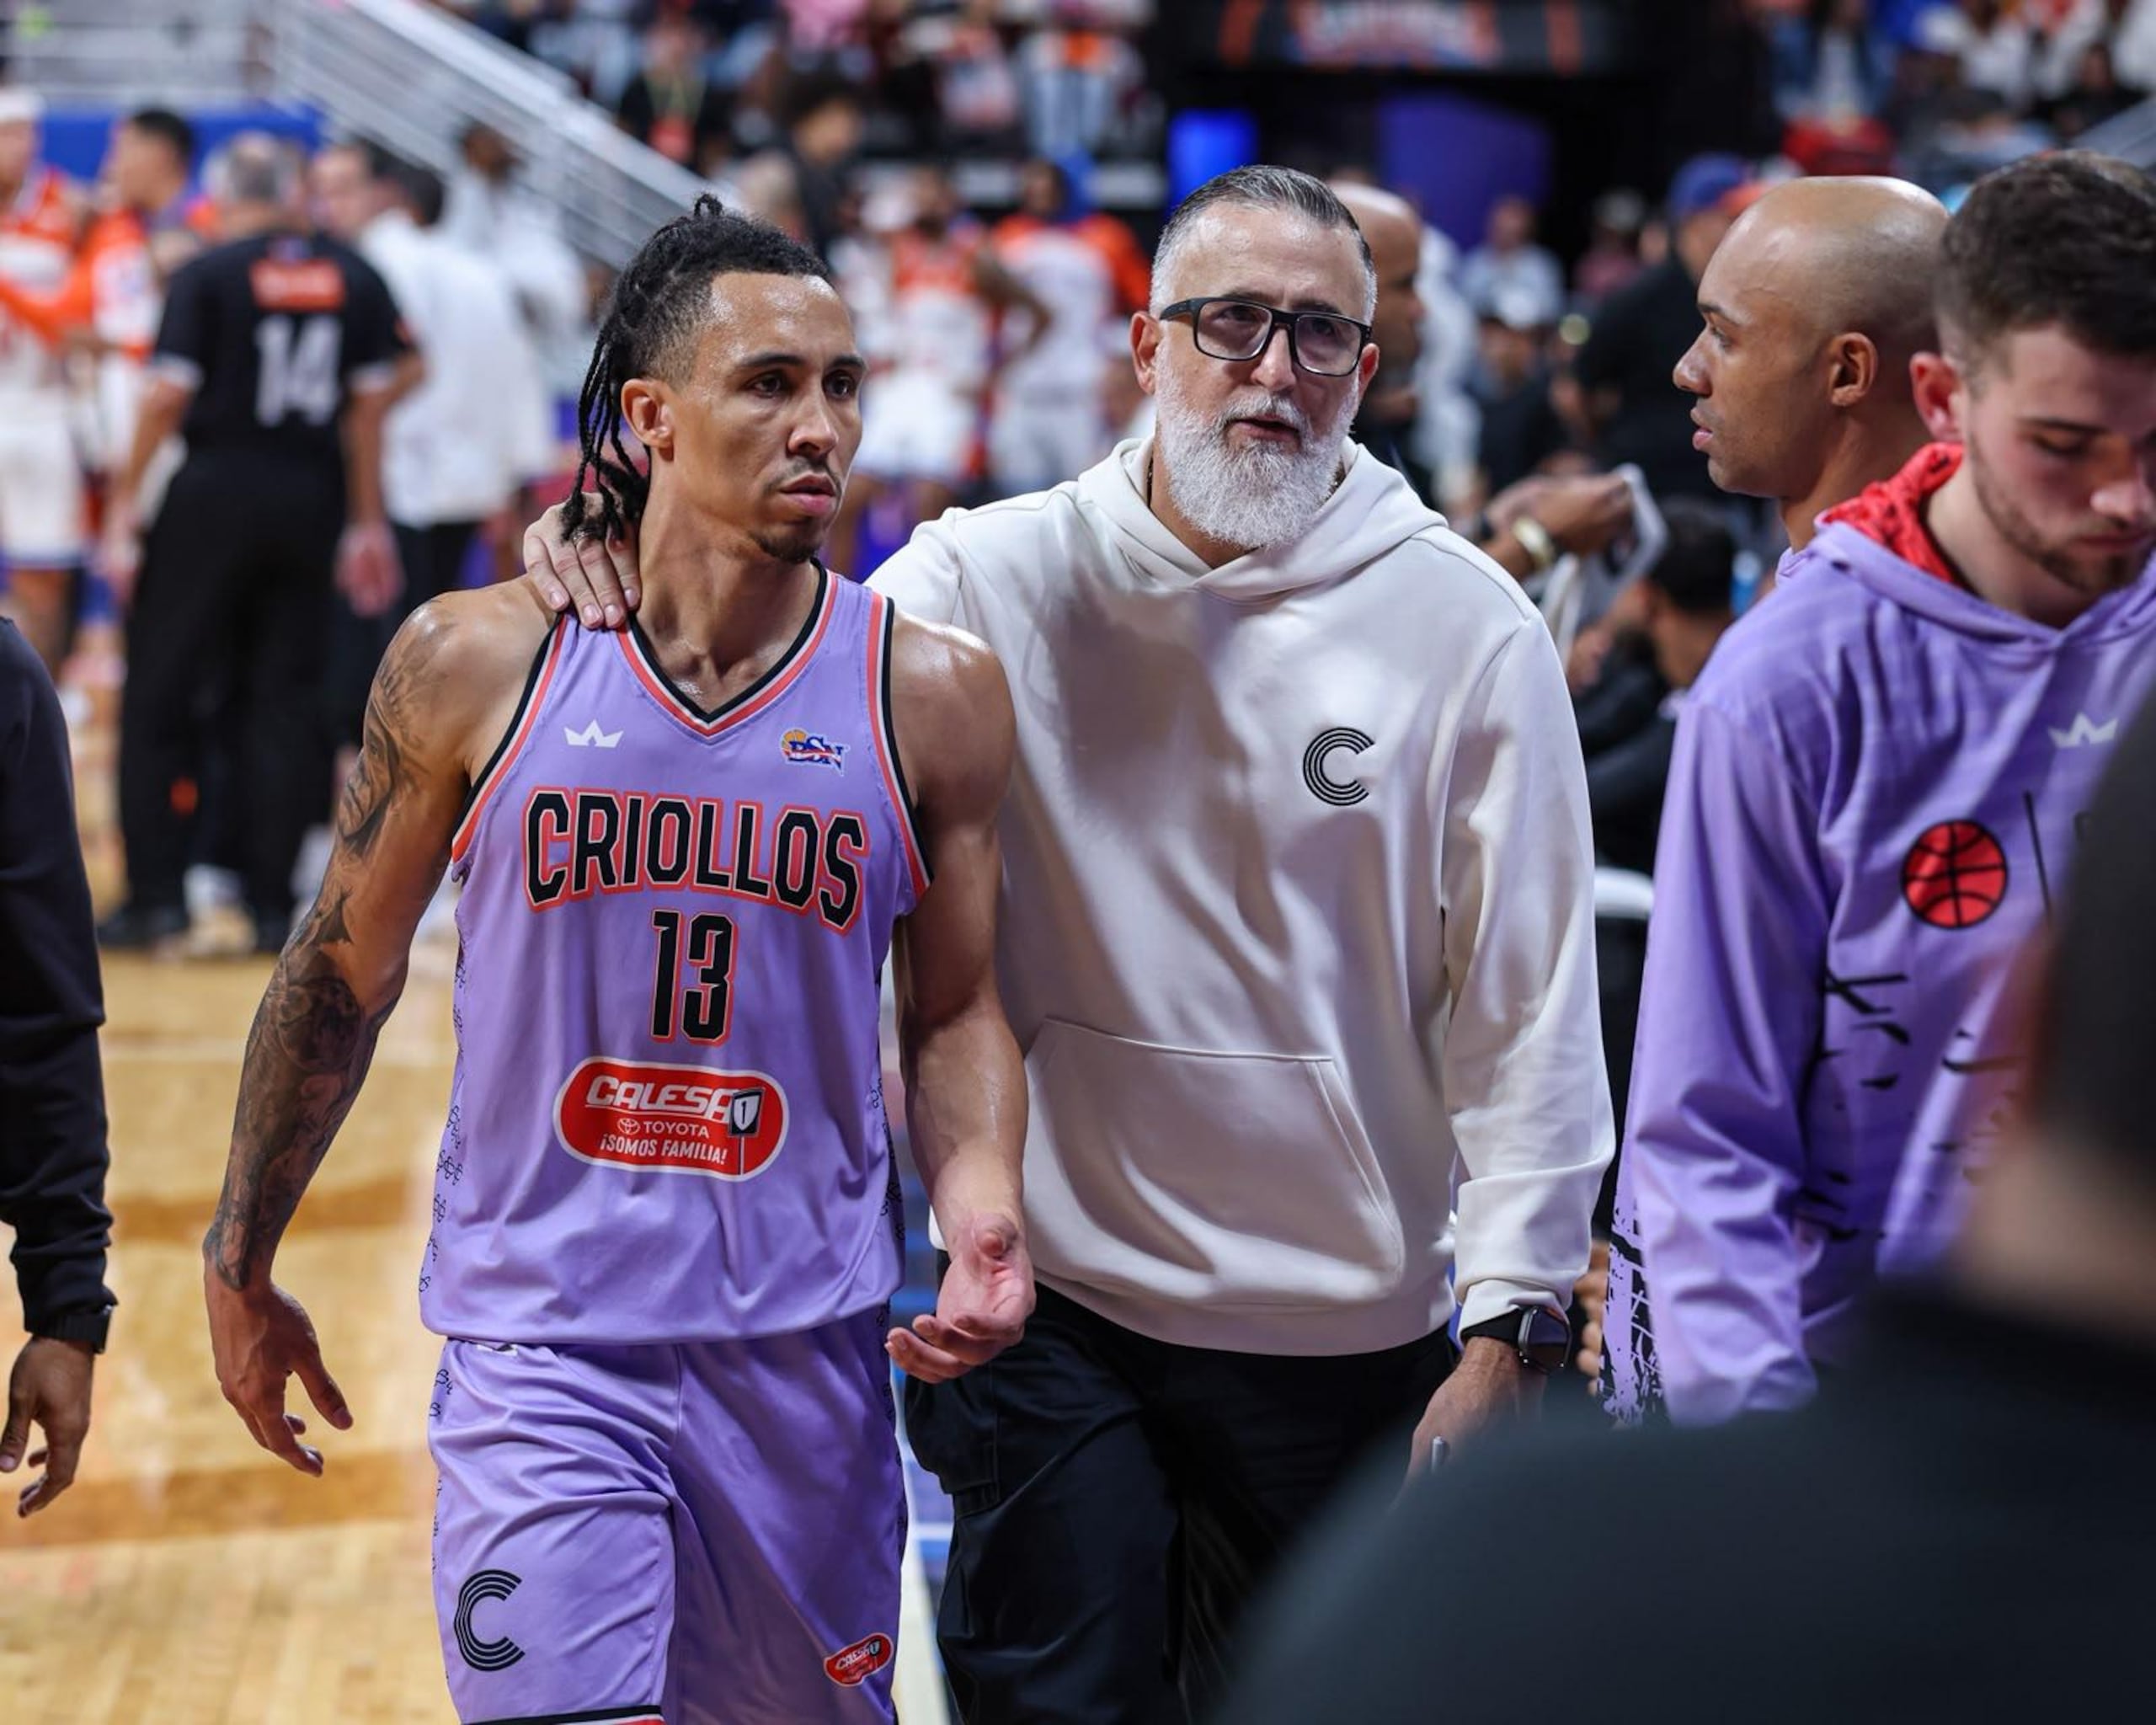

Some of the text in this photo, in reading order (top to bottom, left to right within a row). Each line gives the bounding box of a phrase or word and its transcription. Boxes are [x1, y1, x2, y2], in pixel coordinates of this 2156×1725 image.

[254, 313, 342, 427] 14
[525, 788, 868, 934] CRIOLLOS
[650, 907, 737, 1045] 13
[585, 1075, 733, 1123] CALESA
[643, 1120, 709, 1139] TOYOTA
[600, 1134, 728, 1165] ¡SOMOS FAMILIA!
